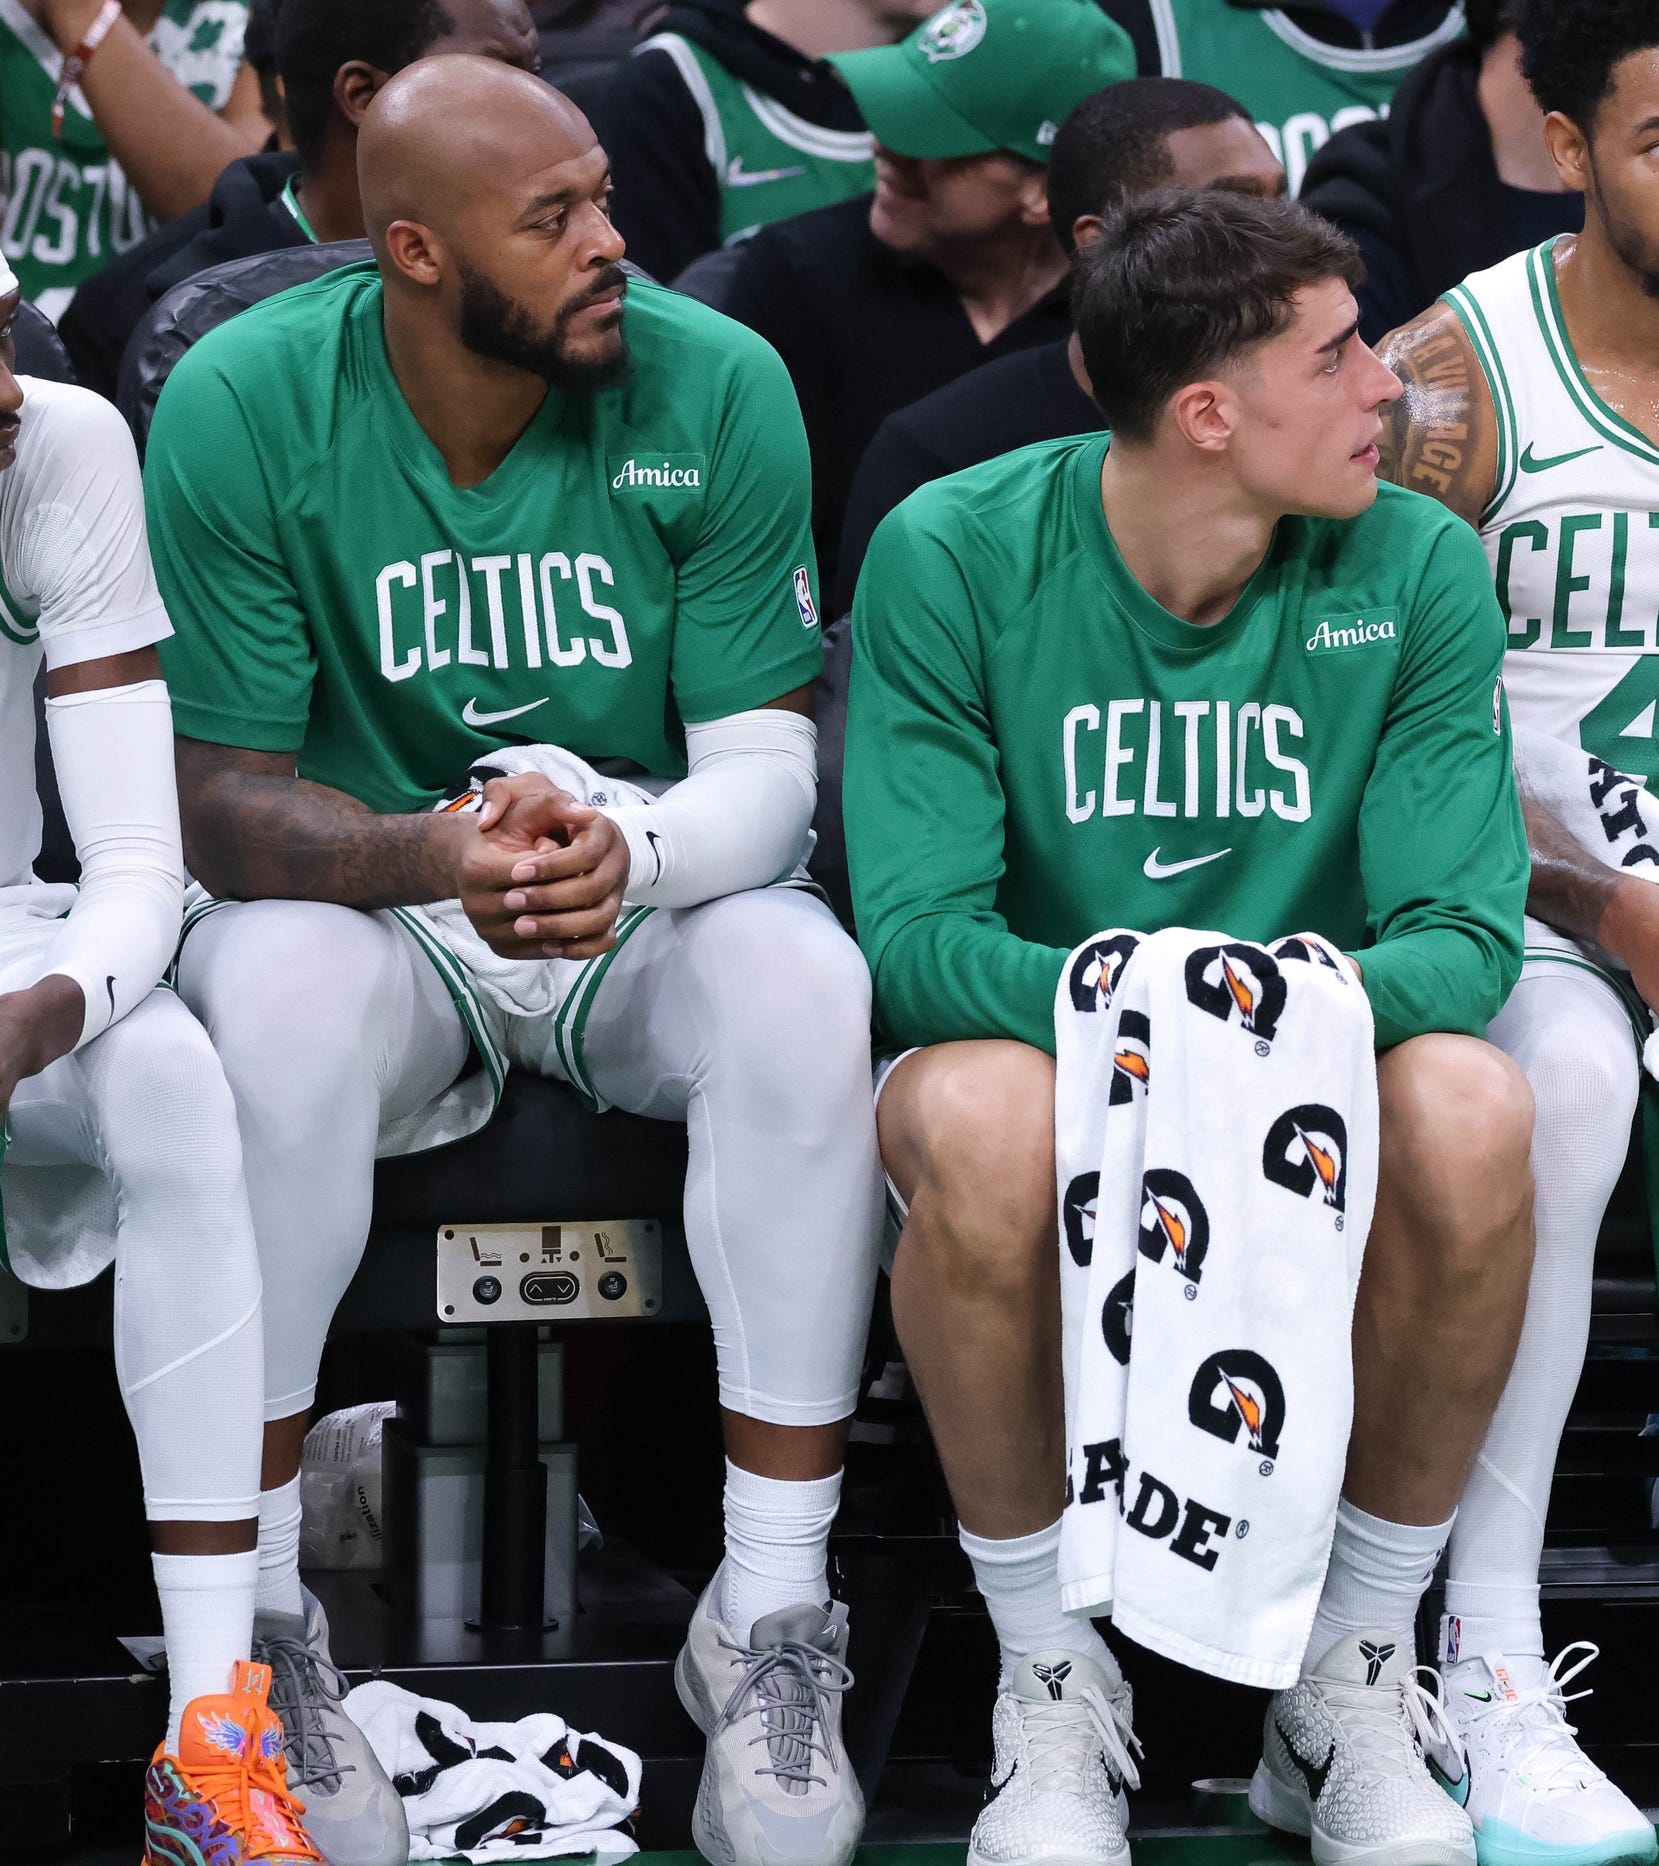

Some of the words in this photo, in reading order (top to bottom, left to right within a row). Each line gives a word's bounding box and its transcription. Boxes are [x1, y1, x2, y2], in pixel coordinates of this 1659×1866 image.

[612, 458, 700, 489] Amica
[375, 548, 633, 682] CELTICS
[1306, 619, 1396, 651] Amica
[1063, 698, 1311, 824] CELTICS
